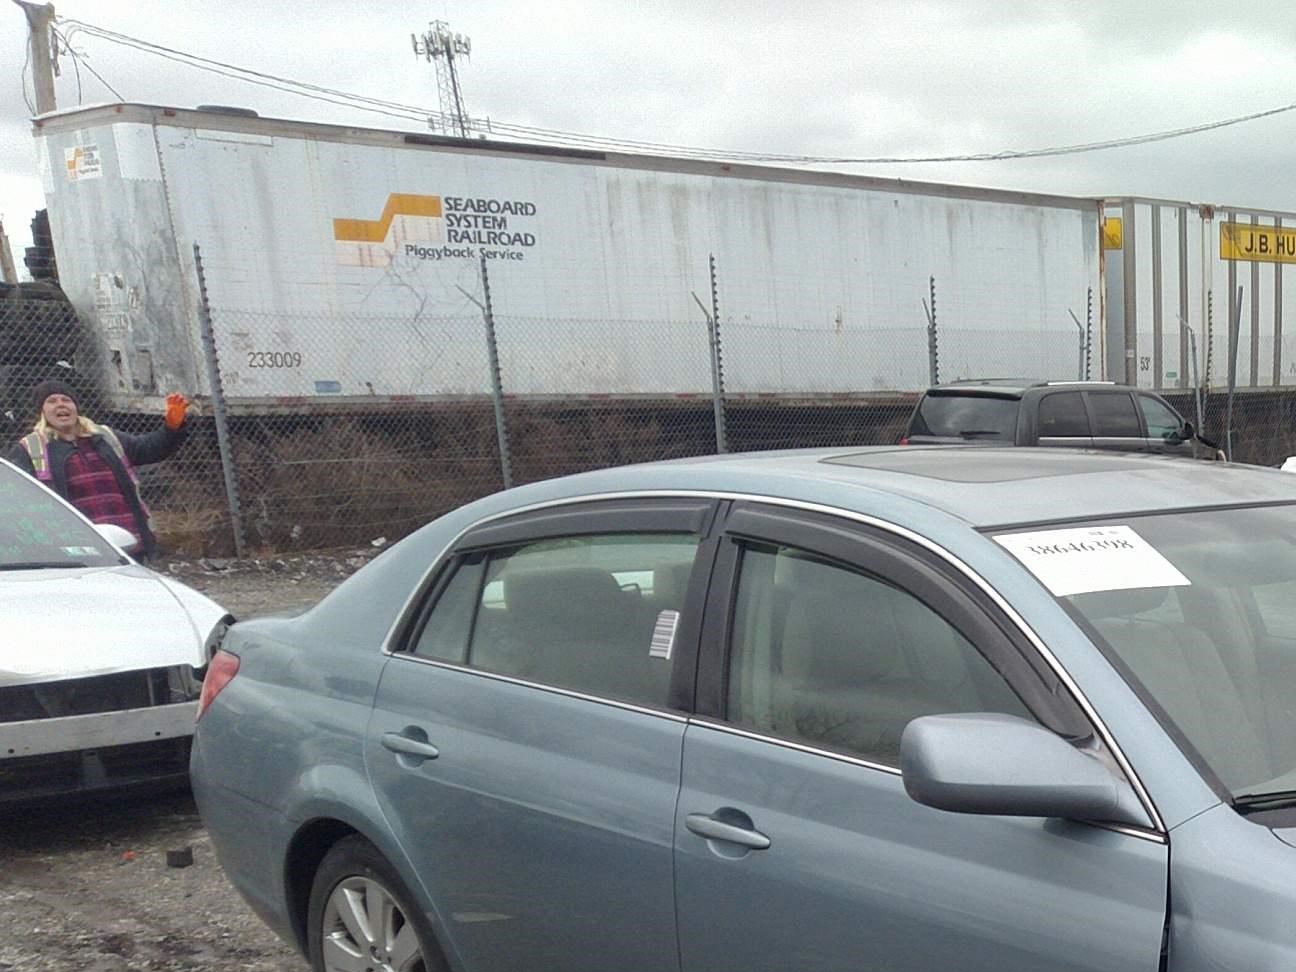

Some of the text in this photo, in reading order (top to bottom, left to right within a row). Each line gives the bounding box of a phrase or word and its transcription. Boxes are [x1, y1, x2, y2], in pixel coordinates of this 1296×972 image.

[444, 197, 537, 216] SEABOARD
[446, 213, 508, 231] SYSTEM
[447, 229, 536, 247] RAILROAD
[1244, 234, 1272, 254] J.B.
[405, 244, 524, 261] Piggyback Service
[247, 351, 302, 368] 233009
